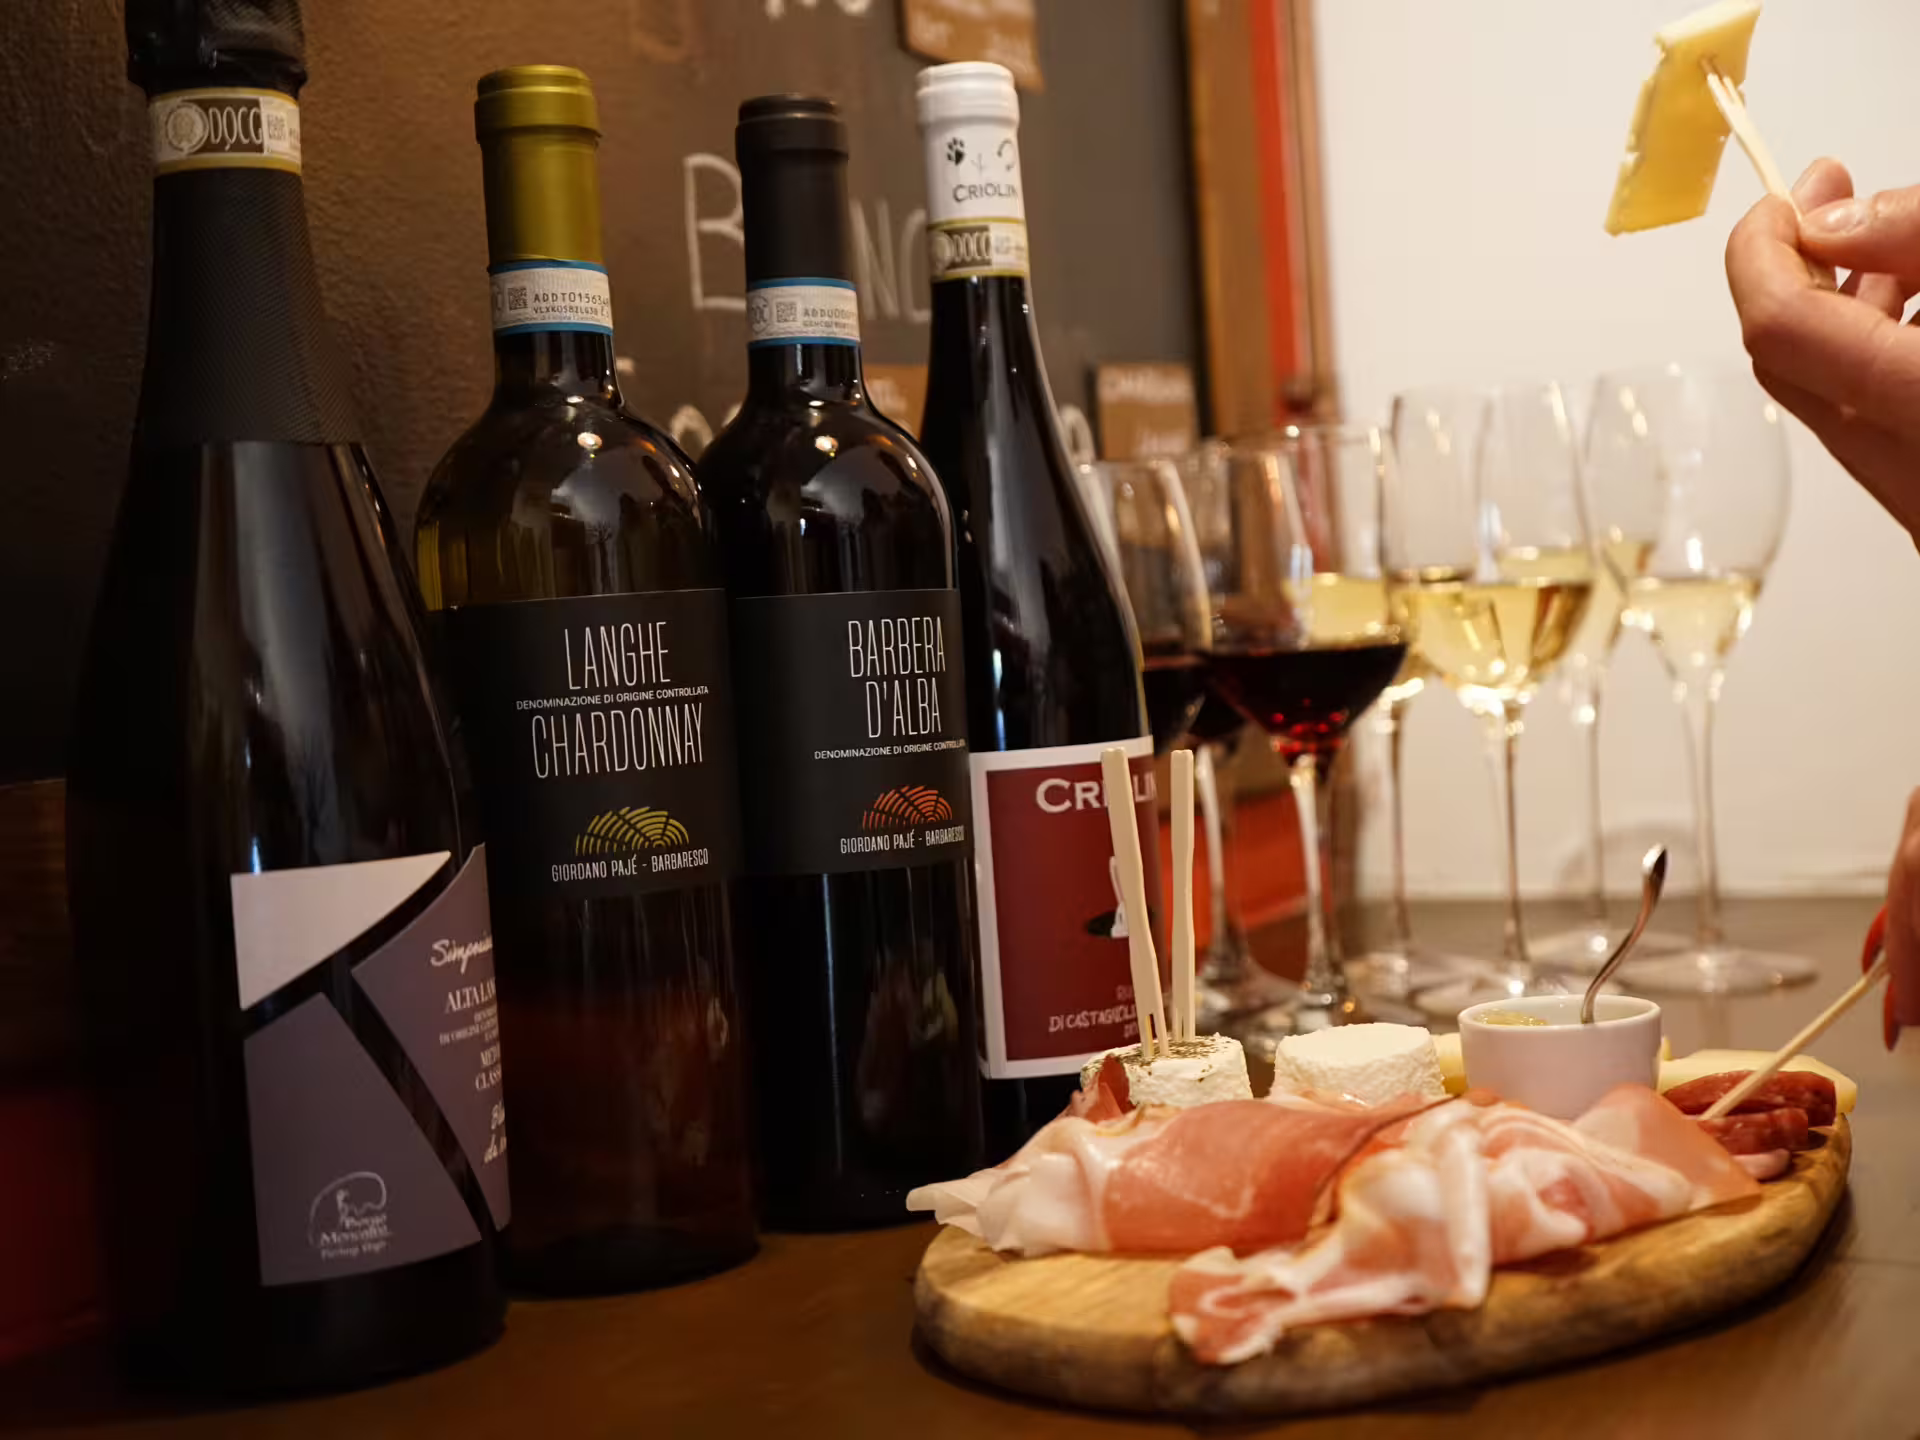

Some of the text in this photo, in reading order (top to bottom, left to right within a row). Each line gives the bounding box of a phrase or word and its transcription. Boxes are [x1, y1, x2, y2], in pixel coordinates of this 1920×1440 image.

[564, 621, 671, 690] LANGHE
[848, 616, 946, 678] BARBERA
[516, 685, 709, 710] DENOMINAZIONE DI ORIGINE CONTROLLATA
[865, 677, 942, 738] D'ALBA
[531, 702, 703, 779] CHARDONNAY
[814, 746, 892, 760] DENOMINAZIONE
[893, 745, 902, 754] DI
[903, 742, 933, 754] ORIGINE
[551, 860, 607, 882] GIORDANO
[611, 853, 638, 876] PAJÉ
[651, 847, 709, 873] BARBARESCO
[840, 834, 890, 854] GIORDANO
[893, 829, 915, 849] PAJÉ
